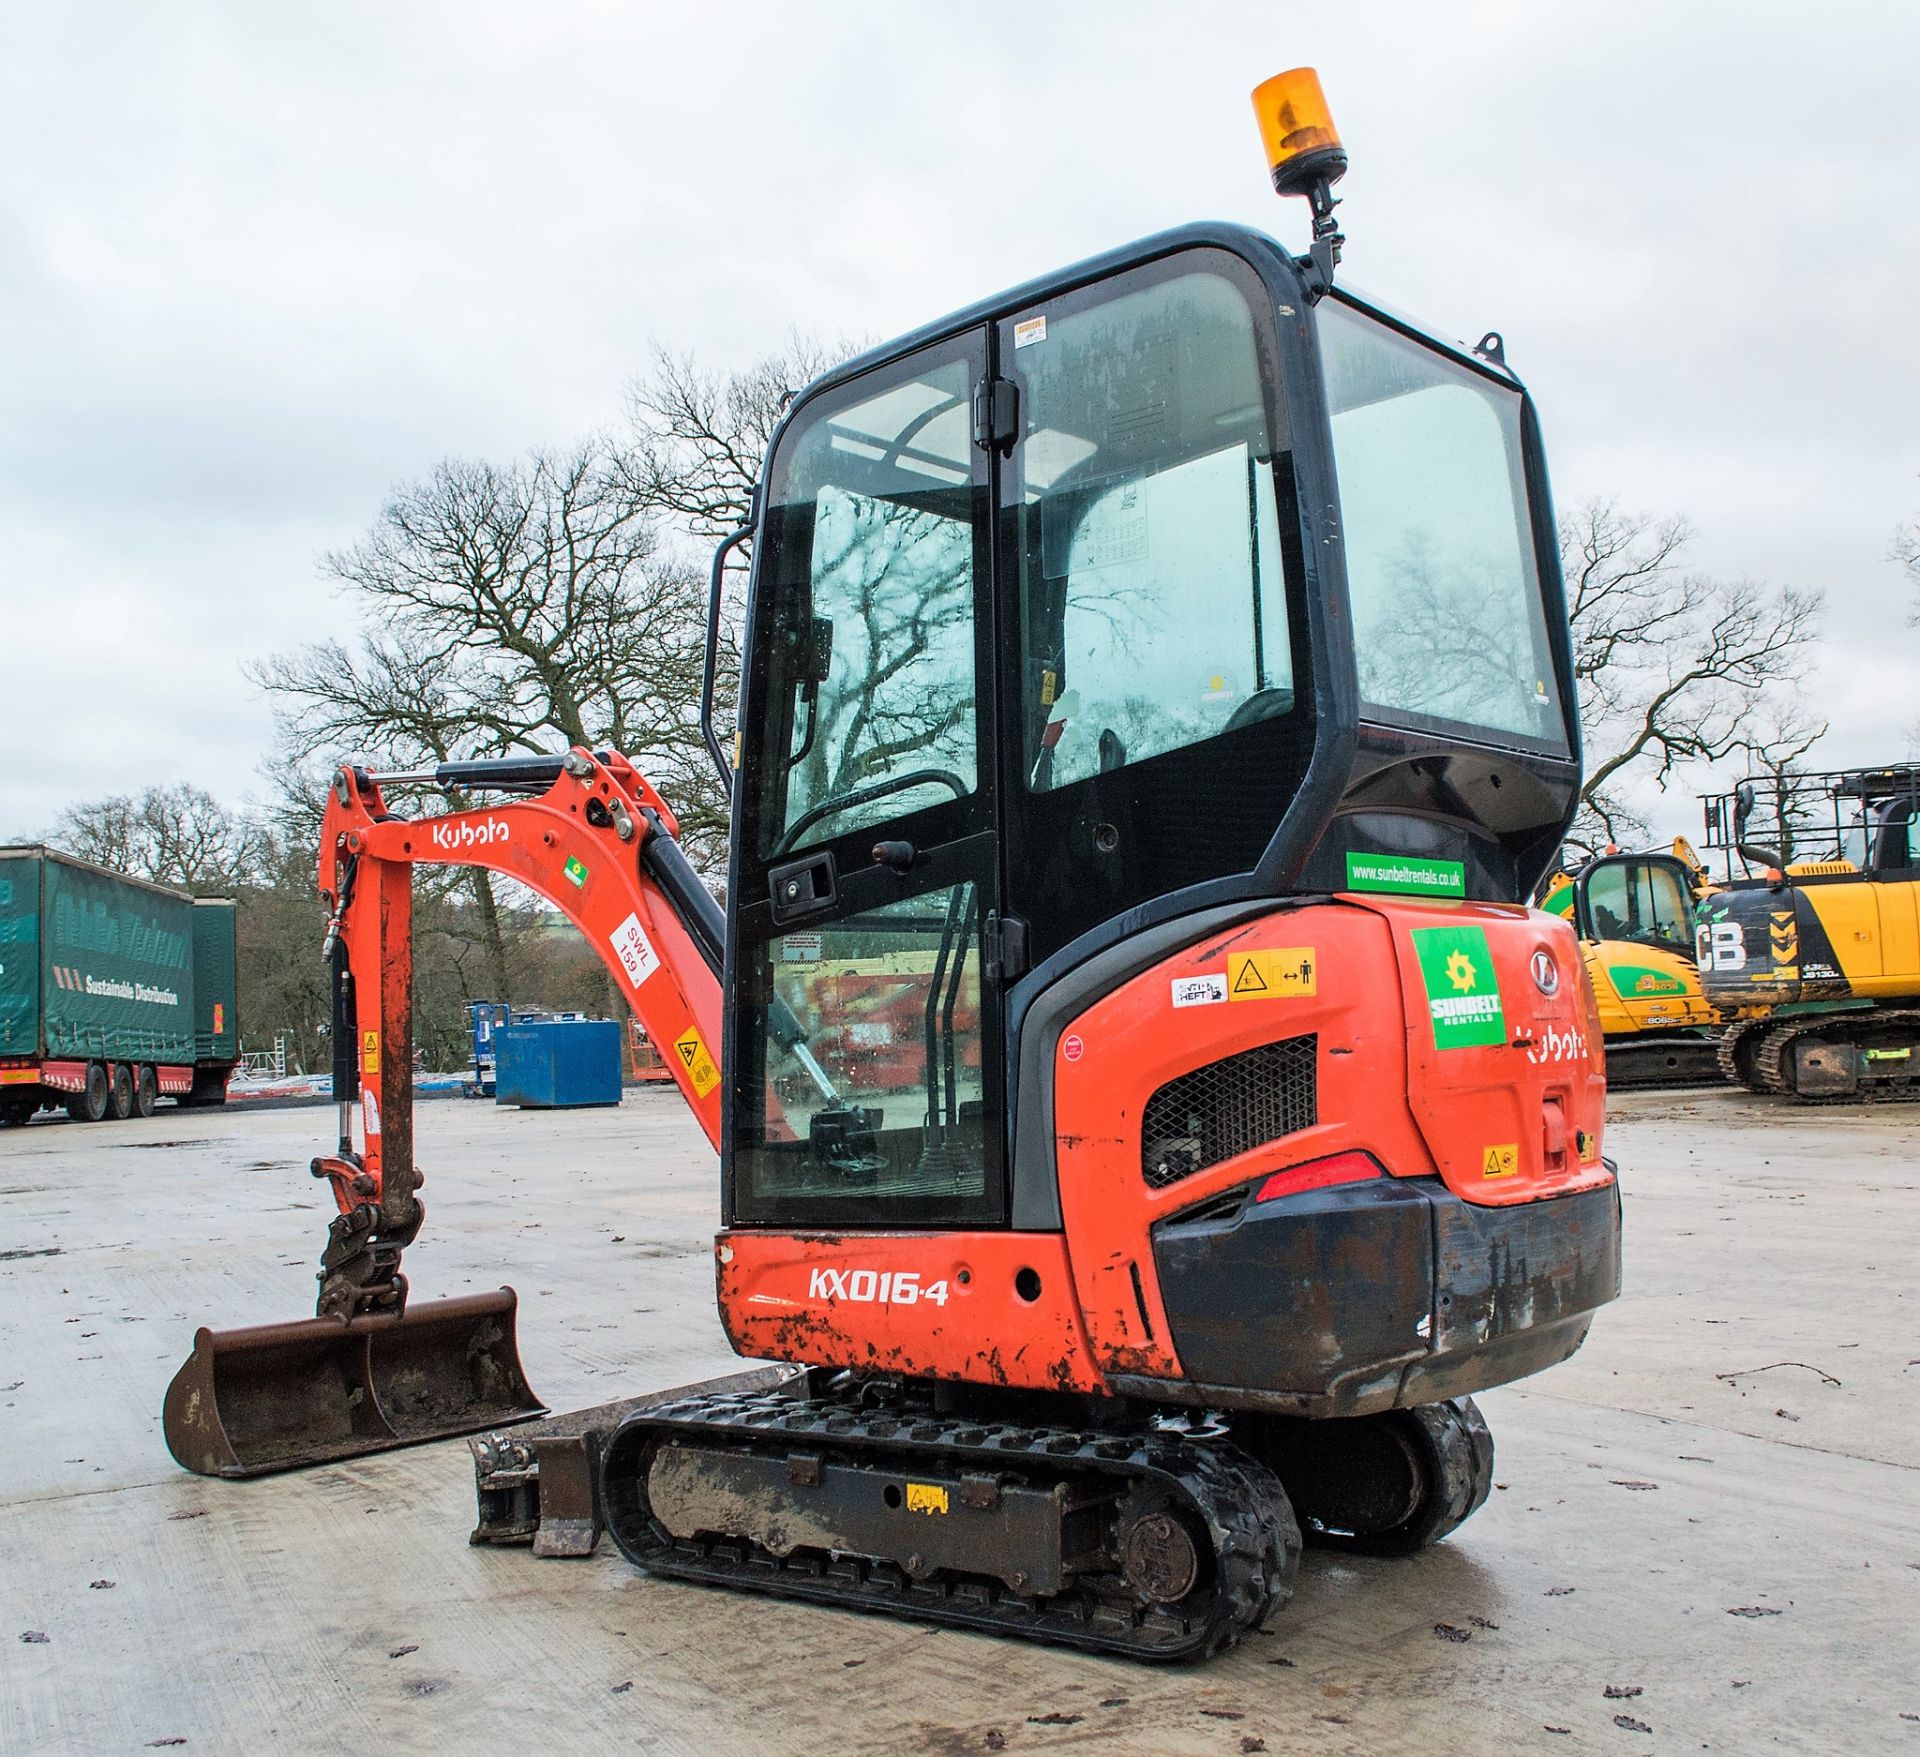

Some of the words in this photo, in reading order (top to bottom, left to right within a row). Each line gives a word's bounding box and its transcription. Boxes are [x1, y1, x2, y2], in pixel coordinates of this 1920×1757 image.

[432, 816, 510, 849] Kubota
[1352, 865, 1461, 887] www.sunbeltrentals.co.uk
[620, 943, 638, 972] 159
[627, 927, 649, 967] SWL
[86, 974, 134, 1000] Sustainable
[135, 983, 178, 1006] Distribution
[1430, 993, 1501, 1019] SUNBELT
[1443, 1013, 1494, 1026] RENTALS
